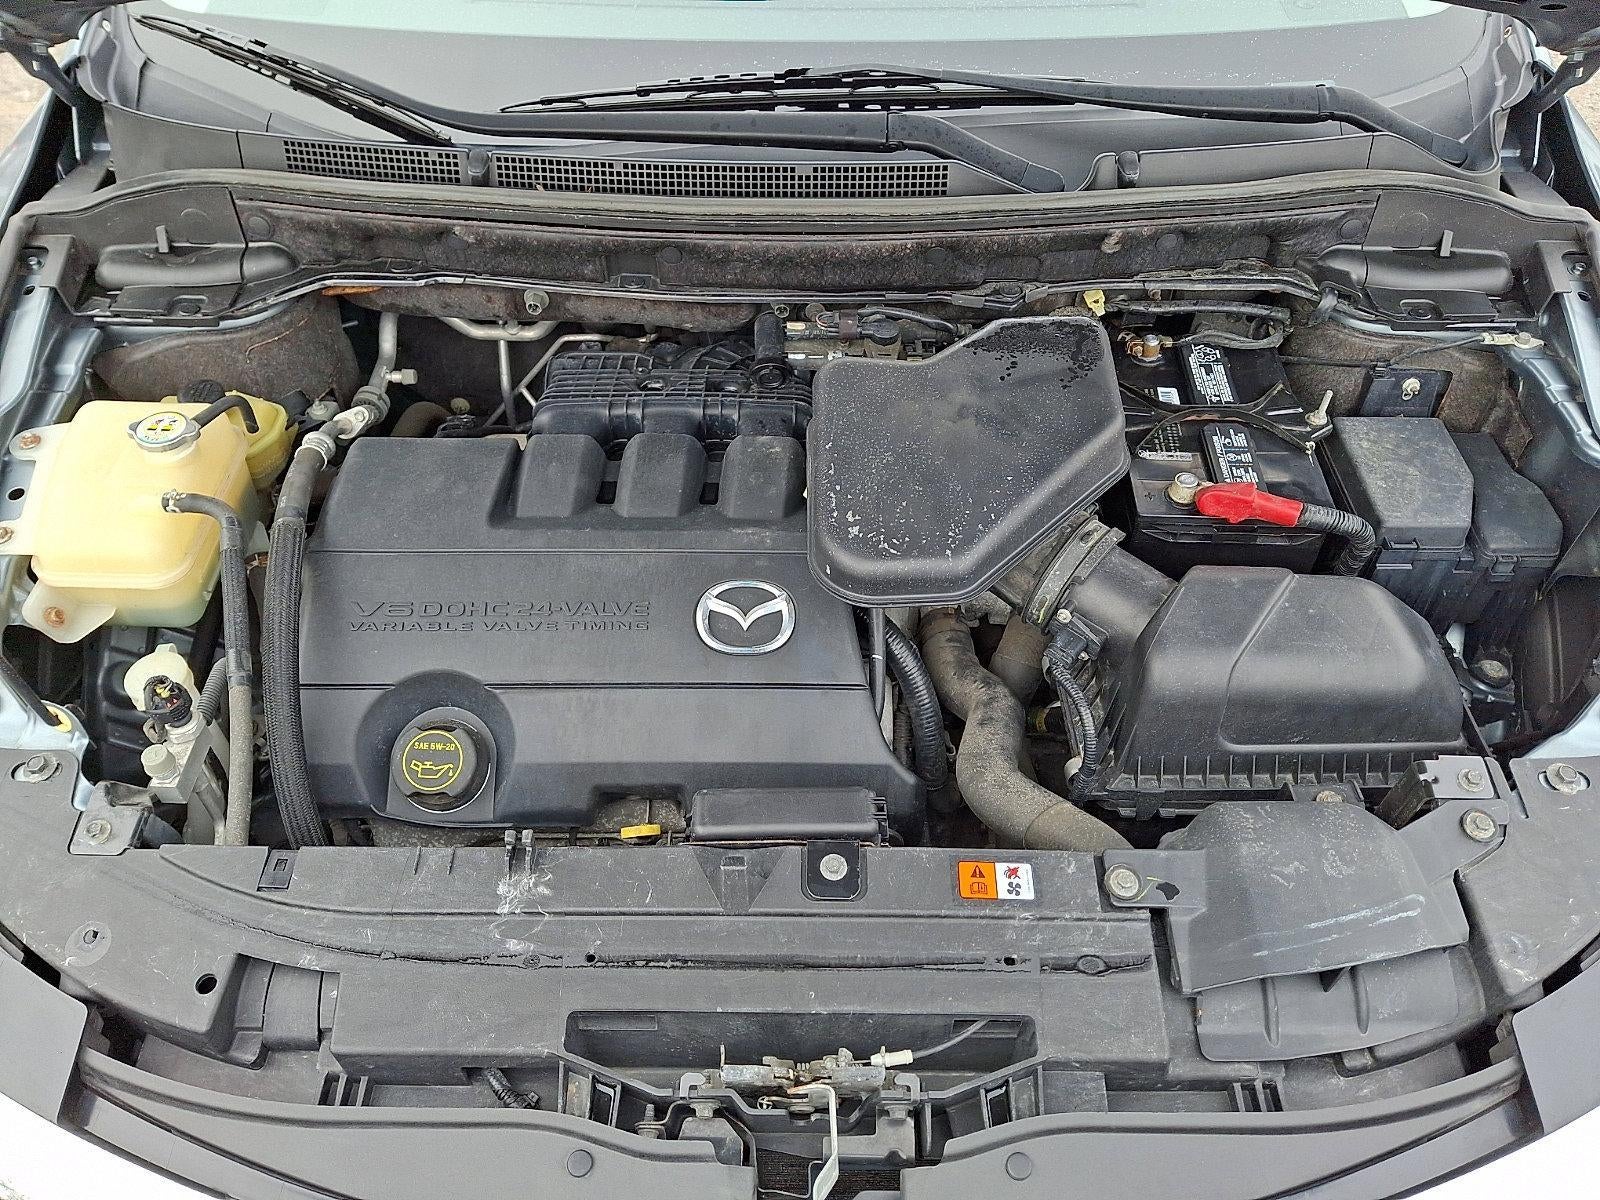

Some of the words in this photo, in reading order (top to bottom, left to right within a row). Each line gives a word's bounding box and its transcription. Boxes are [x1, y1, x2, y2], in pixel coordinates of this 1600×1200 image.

[1218, 457, 1230, 478] DANGER
[350, 600, 415, 617] V6
[418, 600, 509, 617] DOHC
[512, 600, 650, 616] 24-VALVE
[350, 620, 475, 632] VARIABLE
[482, 620, 560, 632] VALVE
[564, 620, 649, 631] TIMING
[413, 741, 429, 750] SAE
[430, 742, 456, 751] 5W-20
